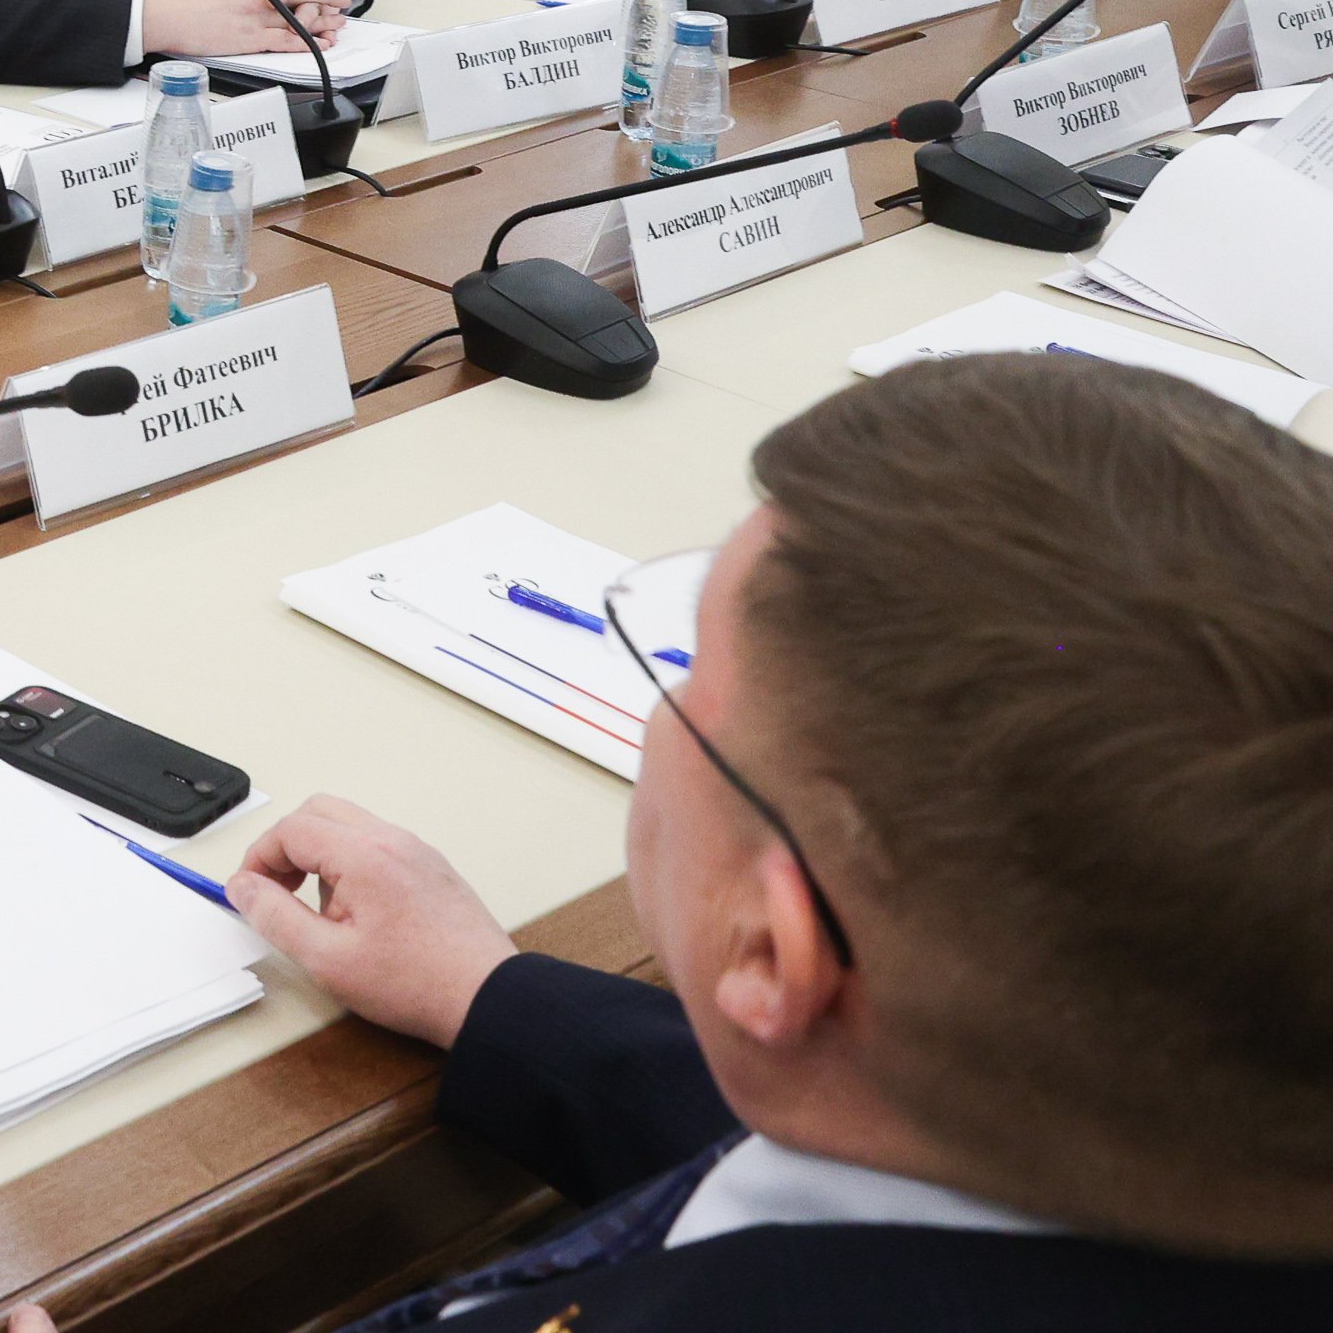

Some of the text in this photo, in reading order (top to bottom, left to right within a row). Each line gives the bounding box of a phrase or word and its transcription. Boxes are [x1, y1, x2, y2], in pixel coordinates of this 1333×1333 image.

[1278, 3, 1326, 30] Сергей
[456, 28, 613, 70] Виктор Викторович
[503, 59, 581, 90] БАЛДИН
[1013, 64, 1147, 117] Виктор Викторович
[1057, 100, 1120, 136] ЗОБНЕВ
[647, 168, 834, 243] Александр Александрович
[719, 215, 781, 253] САВИН
[173, 346, 278, 389] Фатеевич
[141, 392, 245, 443] БРИЛКА
